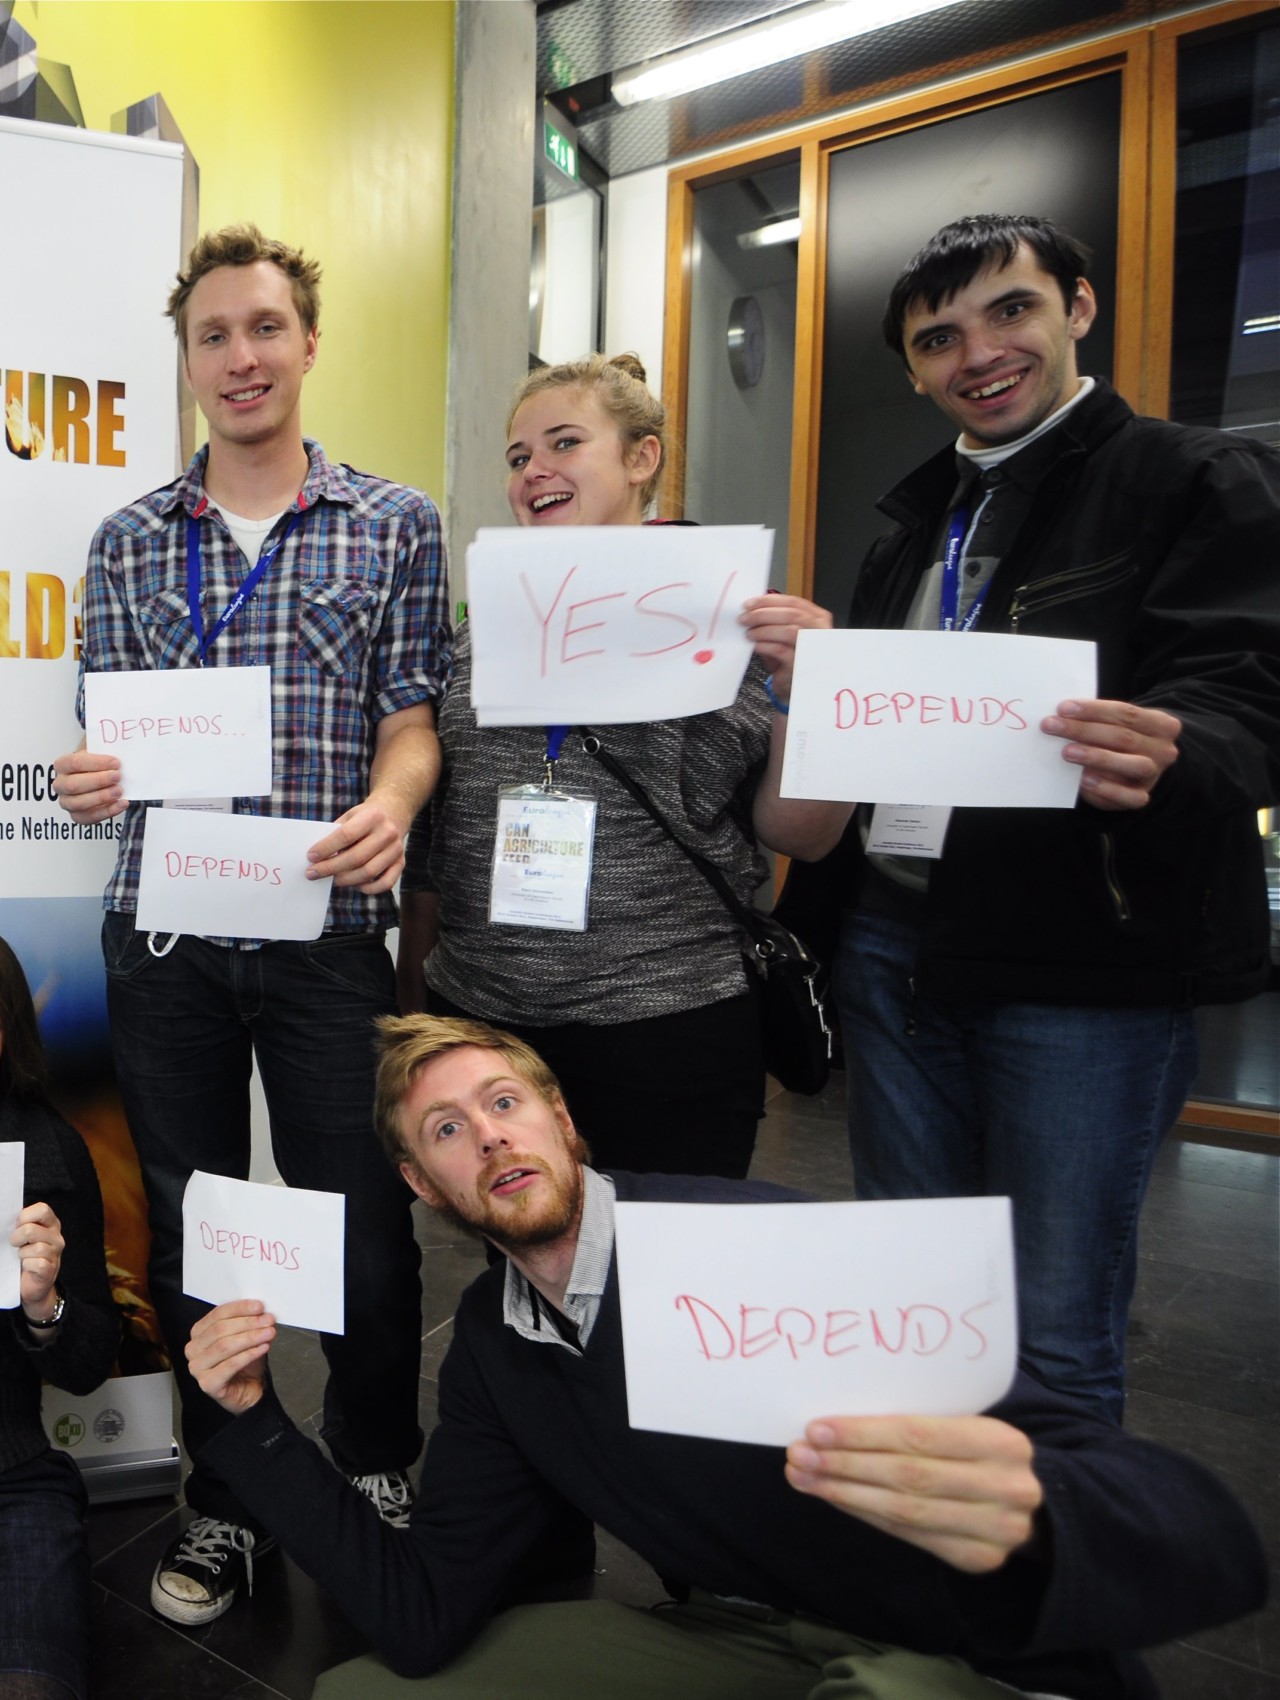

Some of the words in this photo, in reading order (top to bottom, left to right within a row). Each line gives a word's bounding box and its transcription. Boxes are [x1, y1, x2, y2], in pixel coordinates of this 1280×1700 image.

[519, 565, 738, 679] YES!
[833, 688, 1027, 730] DEPENDS
[21, 816, 123, 841] Netherlands
[165, 851, 282, 885] DEPENDS
[200, 1221, 300, 1270] DEPENDS
[675, 1294, 993, 1361] DEPENDS
